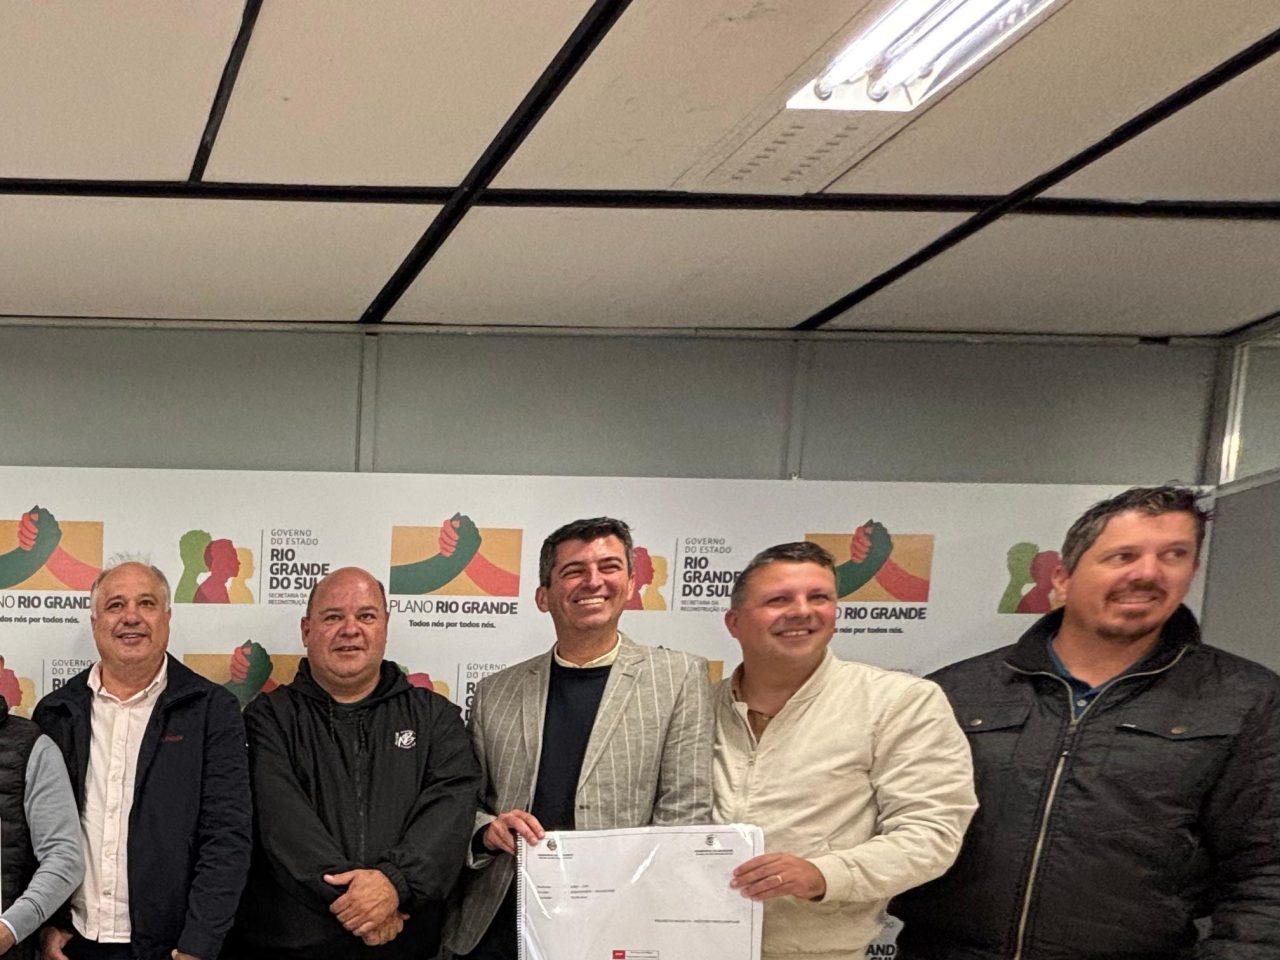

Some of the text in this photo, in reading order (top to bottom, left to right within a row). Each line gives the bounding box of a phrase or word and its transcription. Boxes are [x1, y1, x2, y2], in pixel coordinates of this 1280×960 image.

[271, 529, 312, 537] GOVERNO
[286, 538, 319, 546] ESTADO
[270, 548, 296, 561] RIO
[684, 556, 709, 569] RIO
[269, 563, 330, 576] GRANDE
[269, 577, 291, 589] DO
[682, 584, 732, 597] DO SUL
[17, 596, 41, 609] RIO
[44, 596, 91, 609] GRAND
[389, 600, 518, 614] PLANO RIO GRANDE
[14, 615, 27, 623] nós
[65, 616, 80, 624] nós.
[844, 607, 868, 620] RIO
[870, 607, 927, 620] GRANDE
[431, 620, 444, 628] nós
[854, 627, 865, 635] por
[52, 659, 93, 667] GOVERNO
